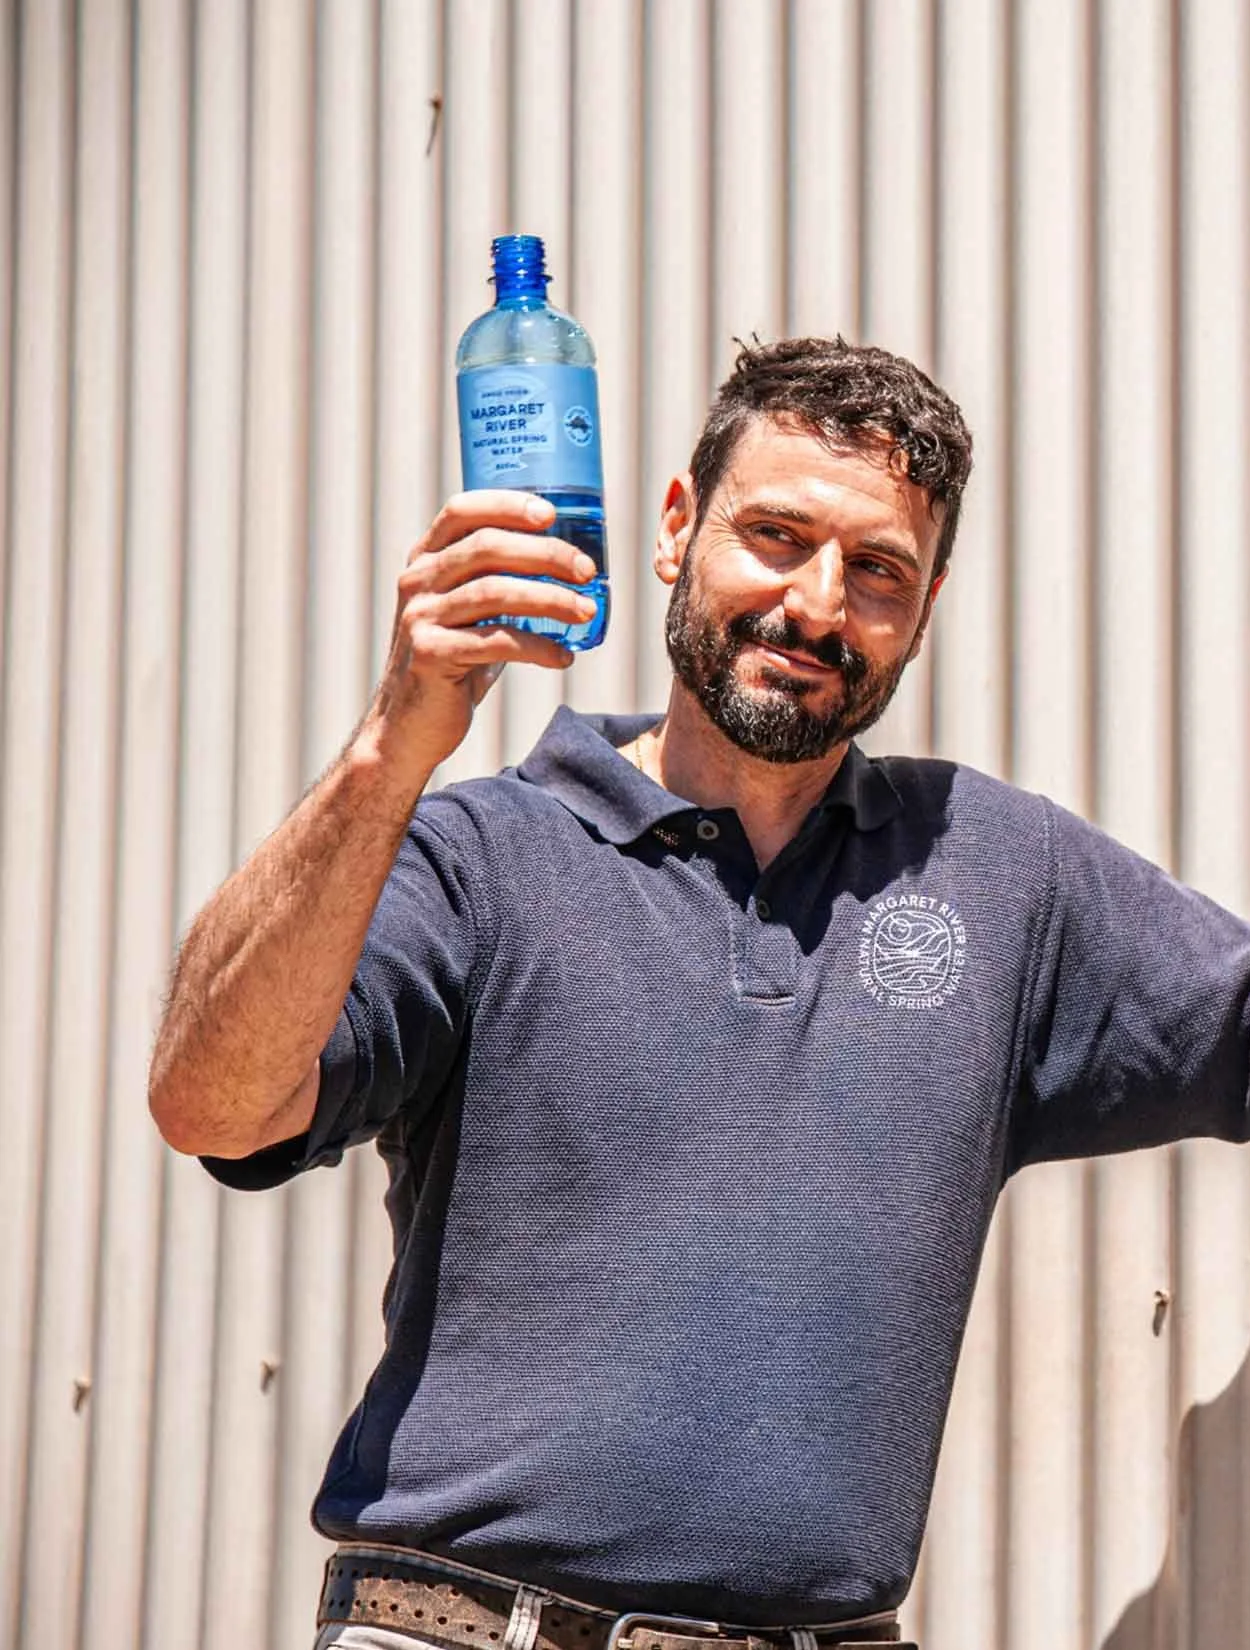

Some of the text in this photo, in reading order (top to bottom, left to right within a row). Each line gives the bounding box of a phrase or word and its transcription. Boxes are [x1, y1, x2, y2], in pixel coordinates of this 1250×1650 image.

[471, 403, 545, 419] MARGARET
[485, 419, 526, 432] RIVER
[473, 435, 547, 448] NATURAL SPRING
[862, 895, 966, 944] MARGARET RIVER
[859, 937, 966, 1009] NATURAL SPRING WATER
